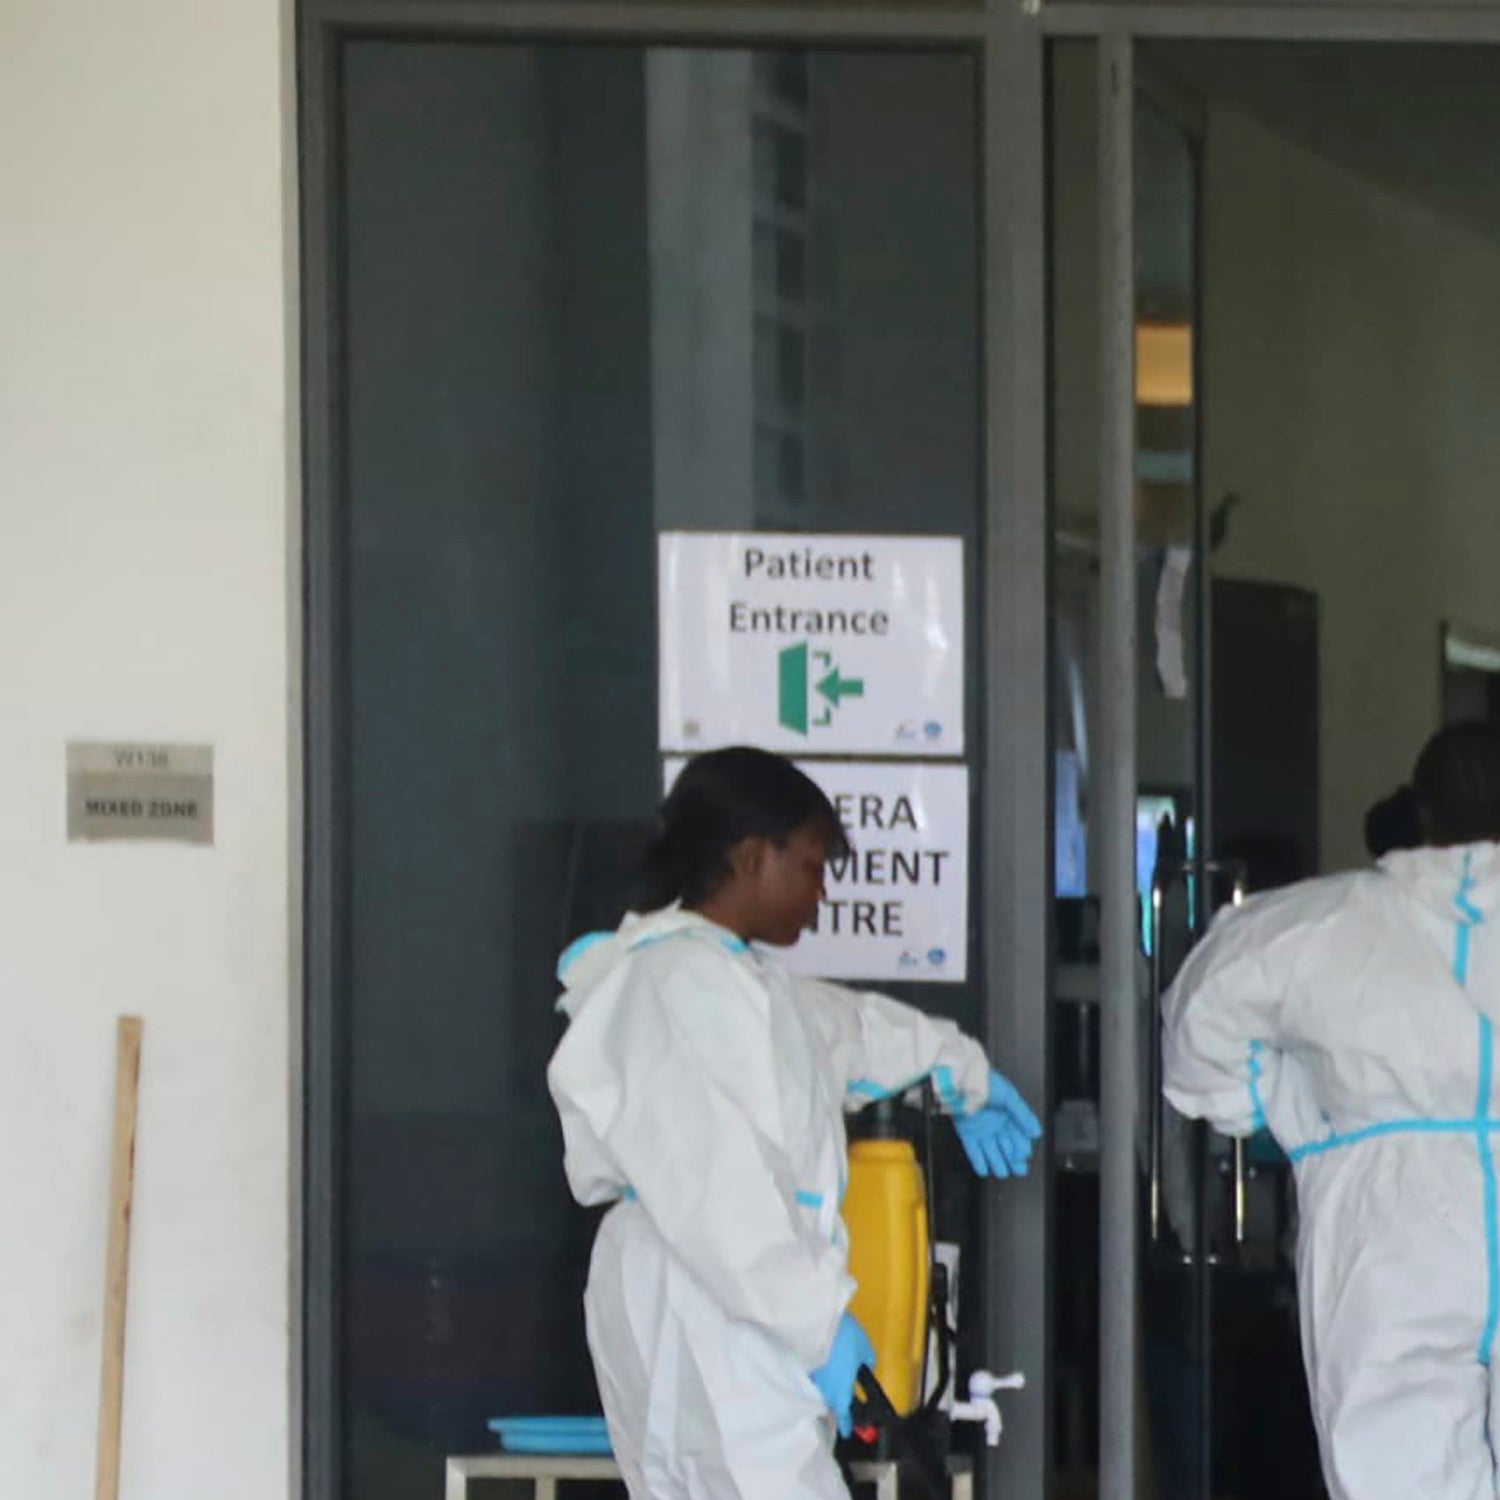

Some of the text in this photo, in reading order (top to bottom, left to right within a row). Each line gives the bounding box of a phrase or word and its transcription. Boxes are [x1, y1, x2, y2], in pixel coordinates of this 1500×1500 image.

[744, 547, 873, 581] Patient
[729, 602, 889, 635] Entrance
[814, 899, 903, 937] TRE
